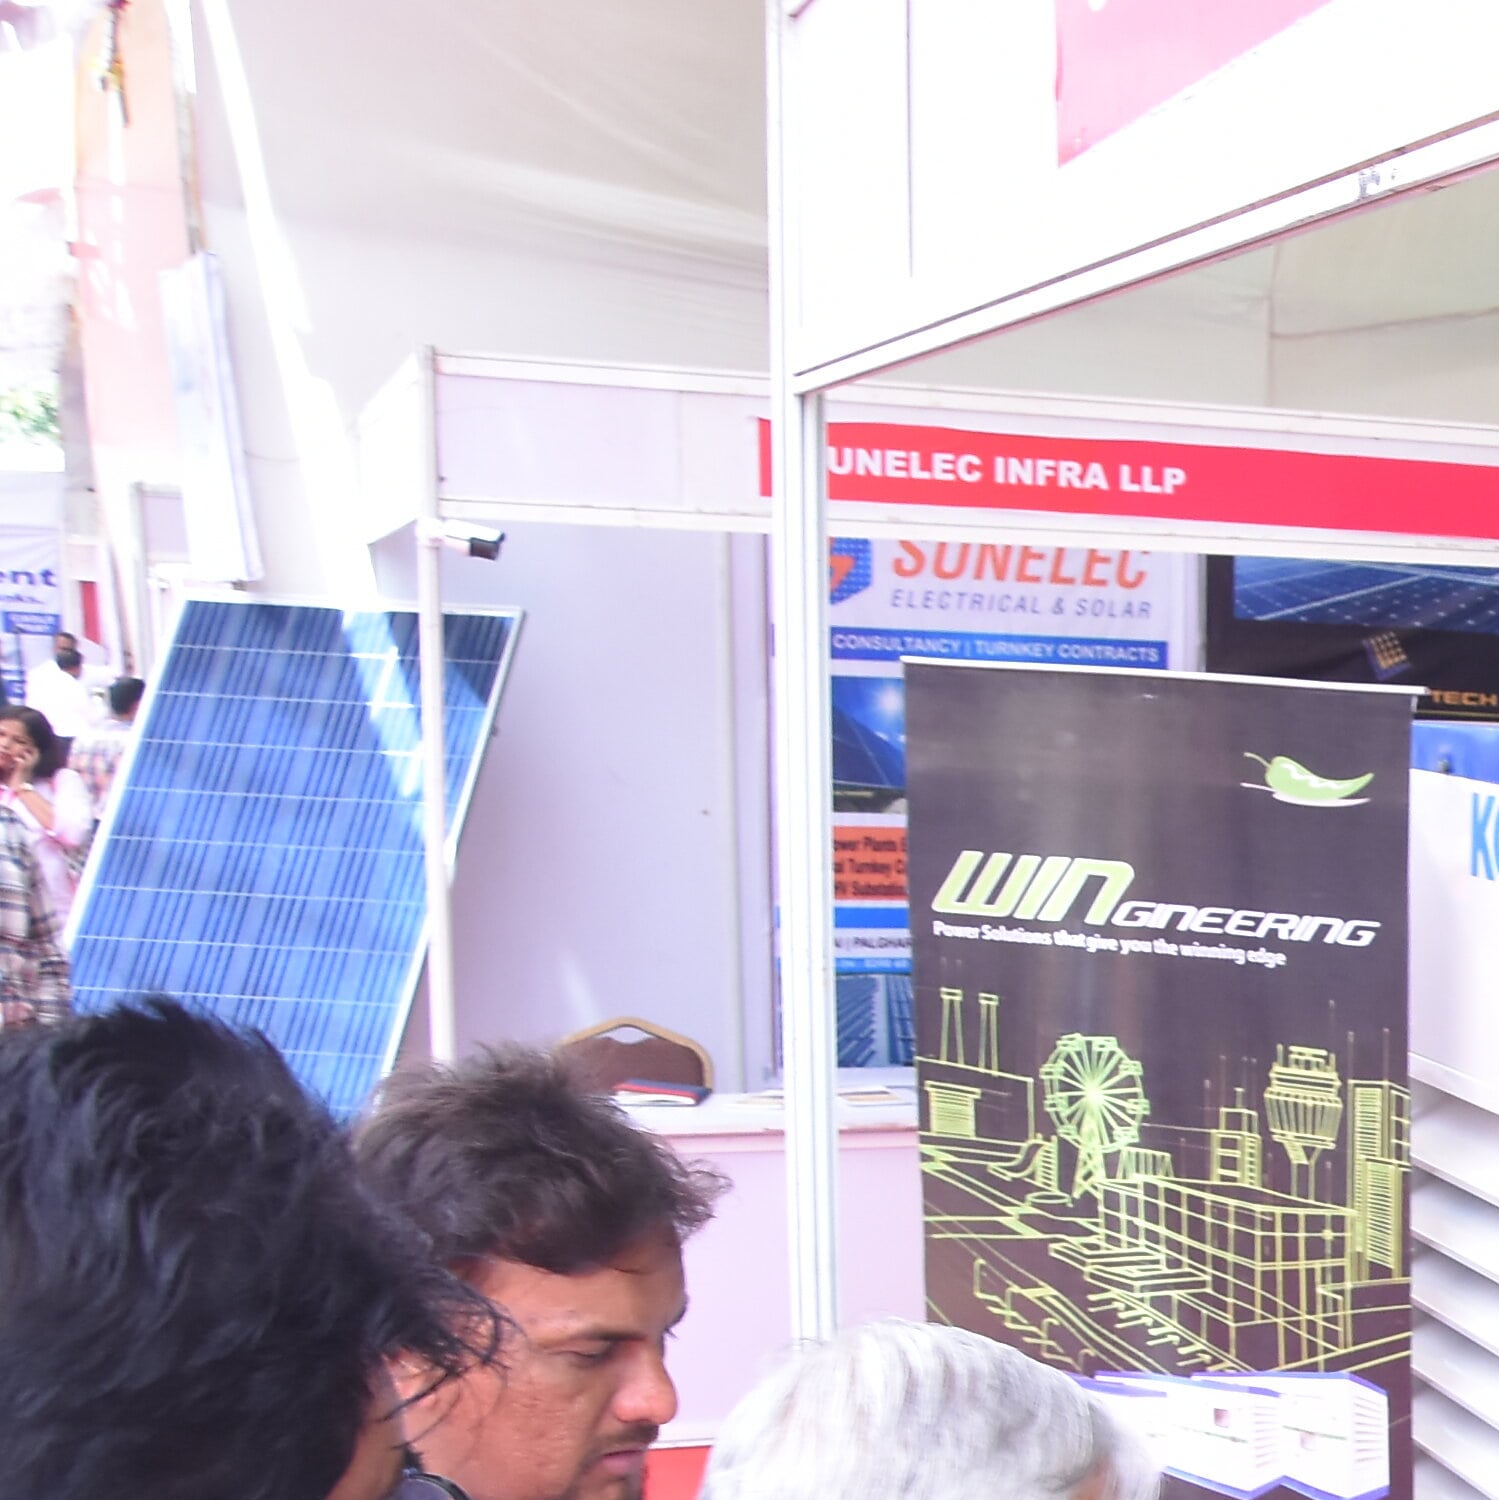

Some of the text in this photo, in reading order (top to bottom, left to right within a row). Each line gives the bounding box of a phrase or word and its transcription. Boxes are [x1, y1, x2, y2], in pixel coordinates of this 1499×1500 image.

[828, 446, 1188, 495] UNELEC INFRA LLP
[891, 588, 1153, 620] ELECTRICAL & SOLAR
[832, 633, 963, 656] CONSULTANCY
[973, 641, 1053, 660] TURNKEY
[1057, 645, 1160, 664] CONTRACTS
[933, 921, 1287, 968] Power Solutions that give you the winning edge
